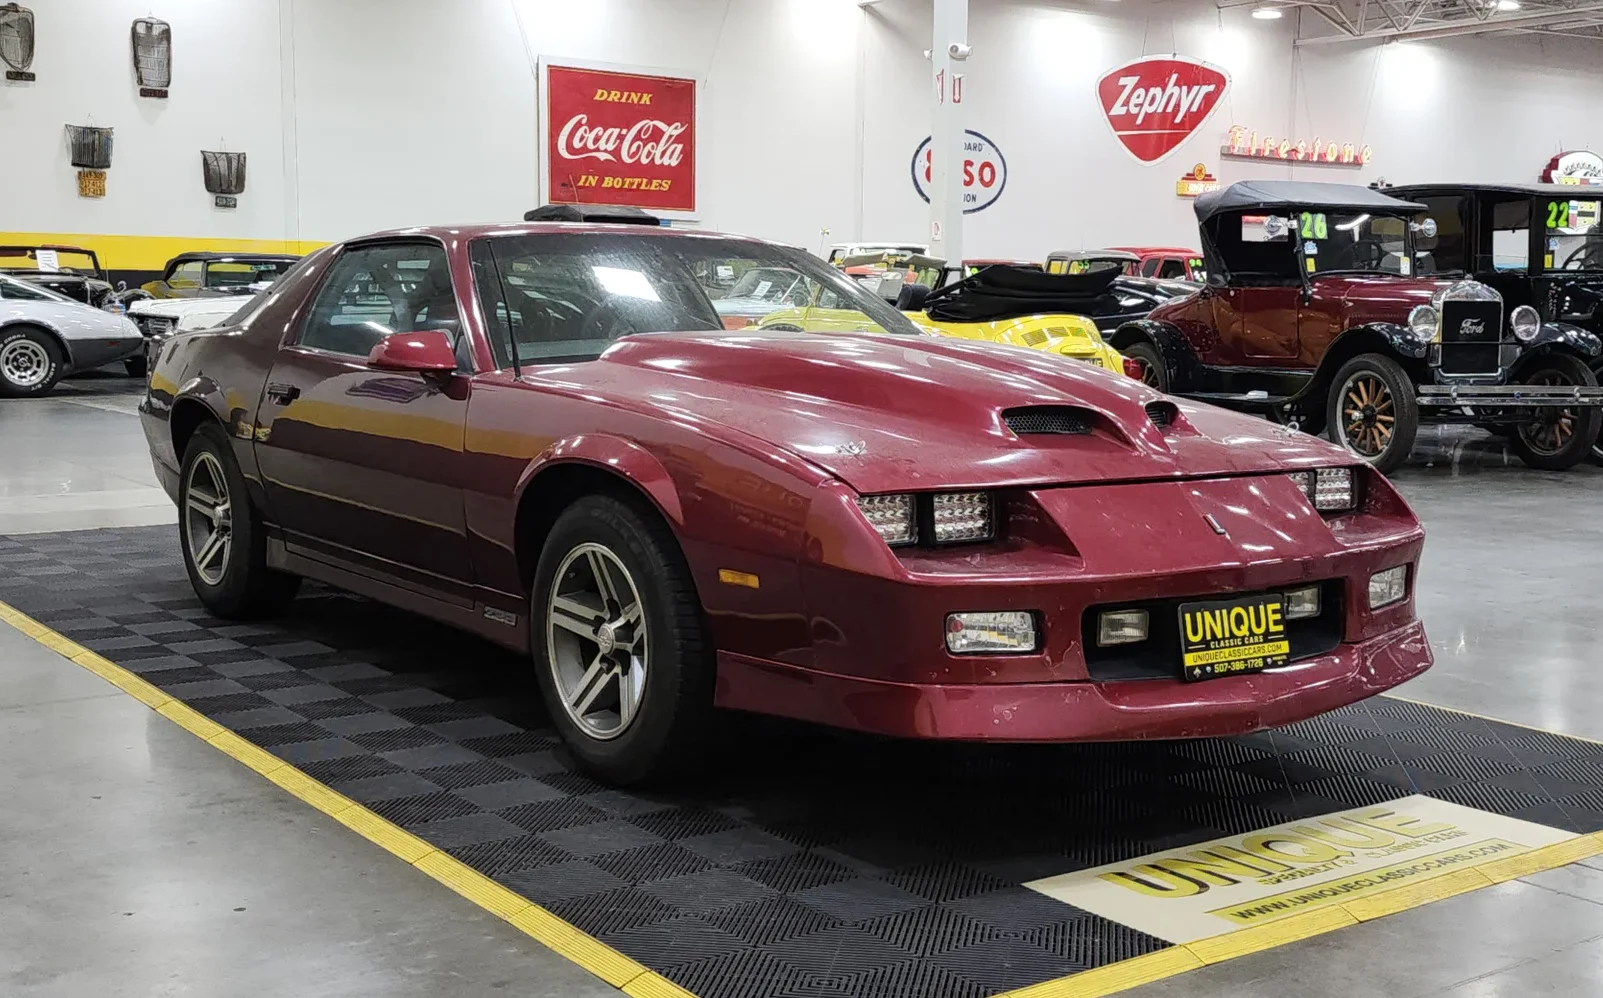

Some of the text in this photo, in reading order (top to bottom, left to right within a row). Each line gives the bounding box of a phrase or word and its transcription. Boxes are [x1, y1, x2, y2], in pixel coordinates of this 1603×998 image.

[593, 88, 654, 105] DRINK
[1108, 73, 1216, 125] Zephyr
[557, 113, 688, 167] Coca-Cola
[1229, 125, 1373, 164] Firestone
[577, 175, 671, 191] IN BOTTLES
[1301, 212, 1327, 239] 26
[1546, 202, 1569, 228] 22
[1460, 318, 1485, 335] Ford
[1185, 603, 1284, 643] UNIQUE
[1192, 645, 1283, 663] UNIQUECLASSICCARS.COM
[1210, 635, 1264, 649] CLASSIC CARS
[1214, 658, 1264, 673] 507-386-1726
[1097, 808, 1457, 898] UNIQUE
[1230, 842, 1514, 919] WWW.UNIQUECLASSICCARS.COM
